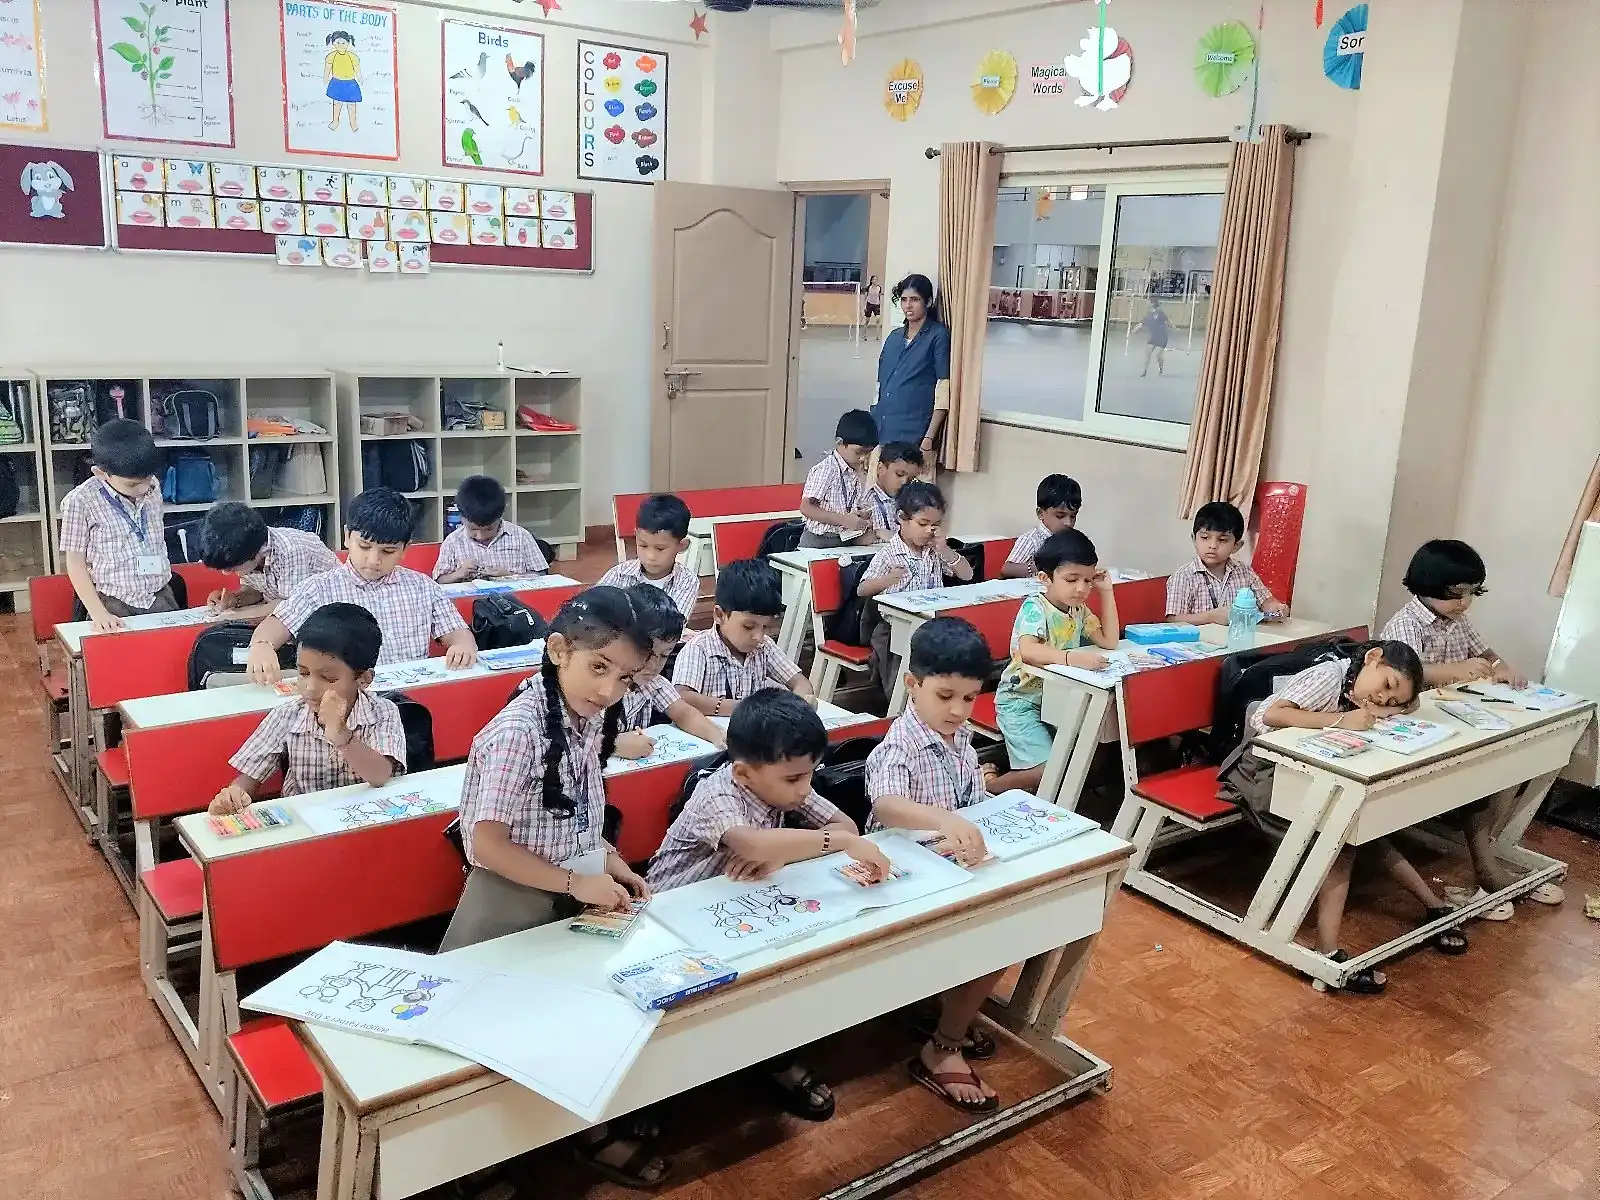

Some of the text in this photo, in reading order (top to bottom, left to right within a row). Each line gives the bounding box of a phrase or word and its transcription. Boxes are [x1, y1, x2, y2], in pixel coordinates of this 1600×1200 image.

[285, 2, 388, 28] PARTS OF THE BODY
[478, 31, 509, 48] Birds
[888, 81, 918, 91] Excuse
[1032, 82, 1063, 94] Words
[895, 93, 906, 103] Me
[304, 1010, 323, 1019] Day
[360, 1023, 390, 1033] Happy
